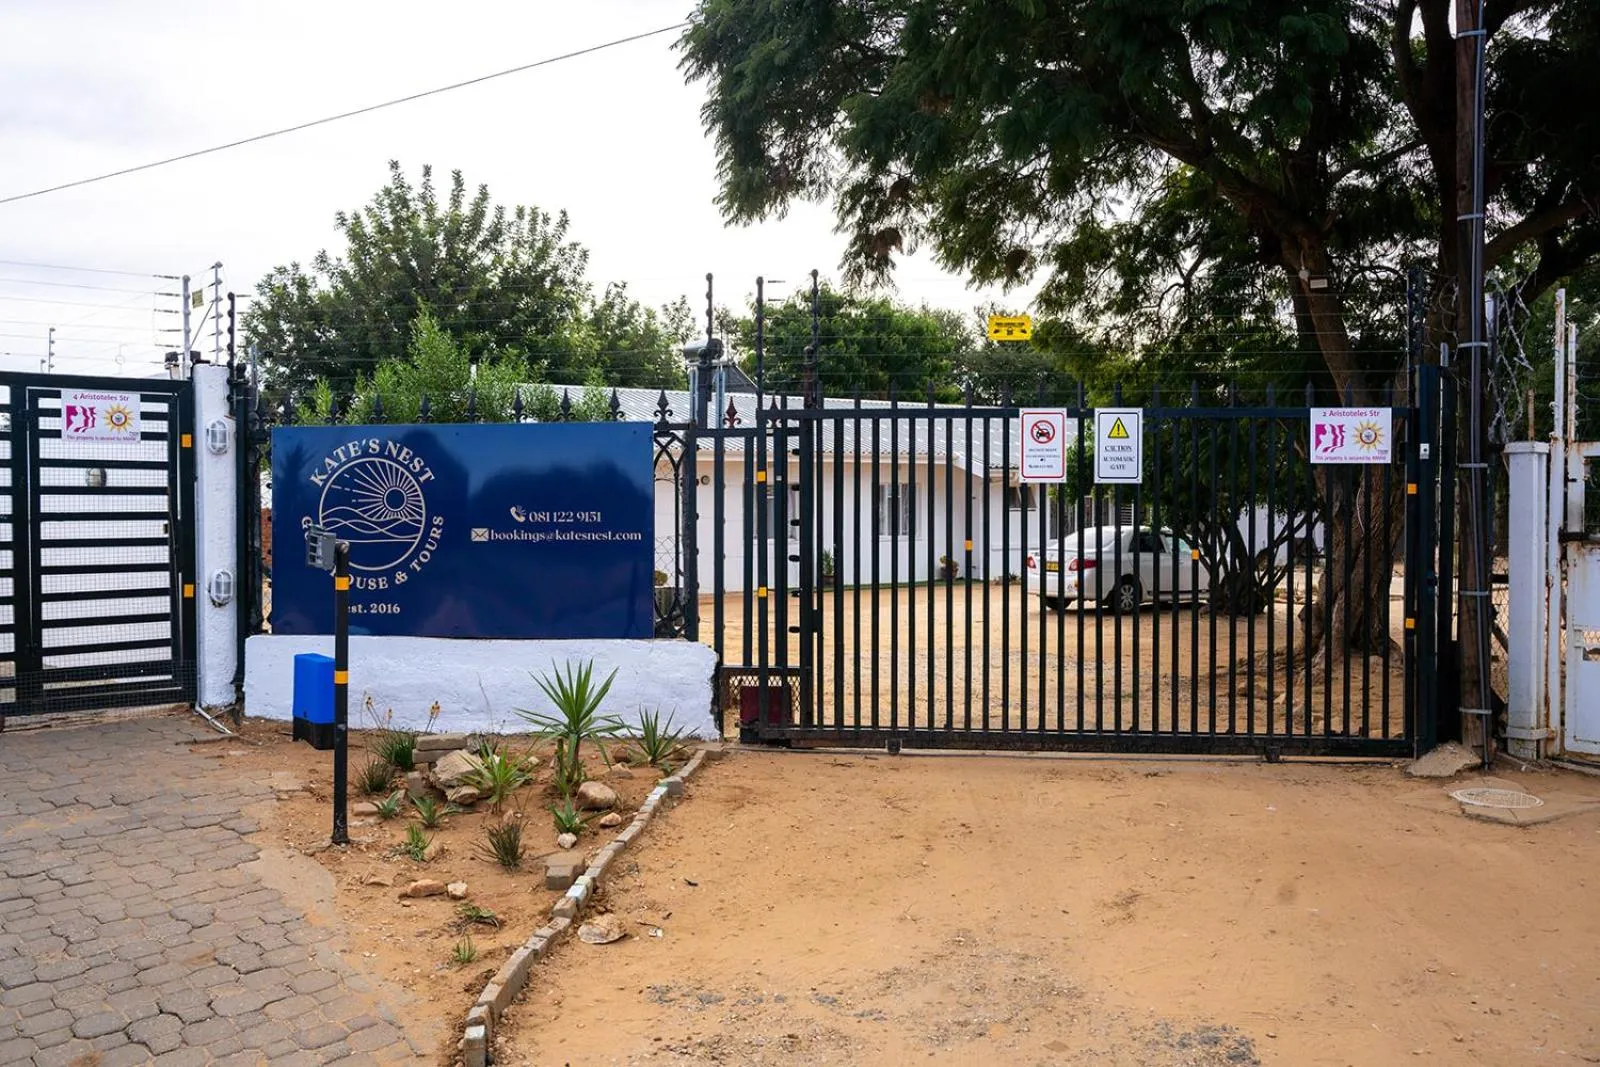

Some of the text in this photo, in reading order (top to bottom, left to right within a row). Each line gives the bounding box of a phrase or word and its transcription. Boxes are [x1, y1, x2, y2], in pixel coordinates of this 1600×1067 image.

[80, 392, 118, 401] Aristoteles
[119, 394, 129, 402] Str
[1328, 409, 1368, 417] Aristoteles
[1369, 409, 1380, 417] Str
[309, 438, 435, 487] KATE'S NEST
[529, 511, 602, 523] 081 122 9151
[490, 529, 642, 543] bookings@katesnest.com
[394, 570, 408, 585] &
[409, 515, 444, 573] TOURS
[347, 603, 400, 614] st. 2016
